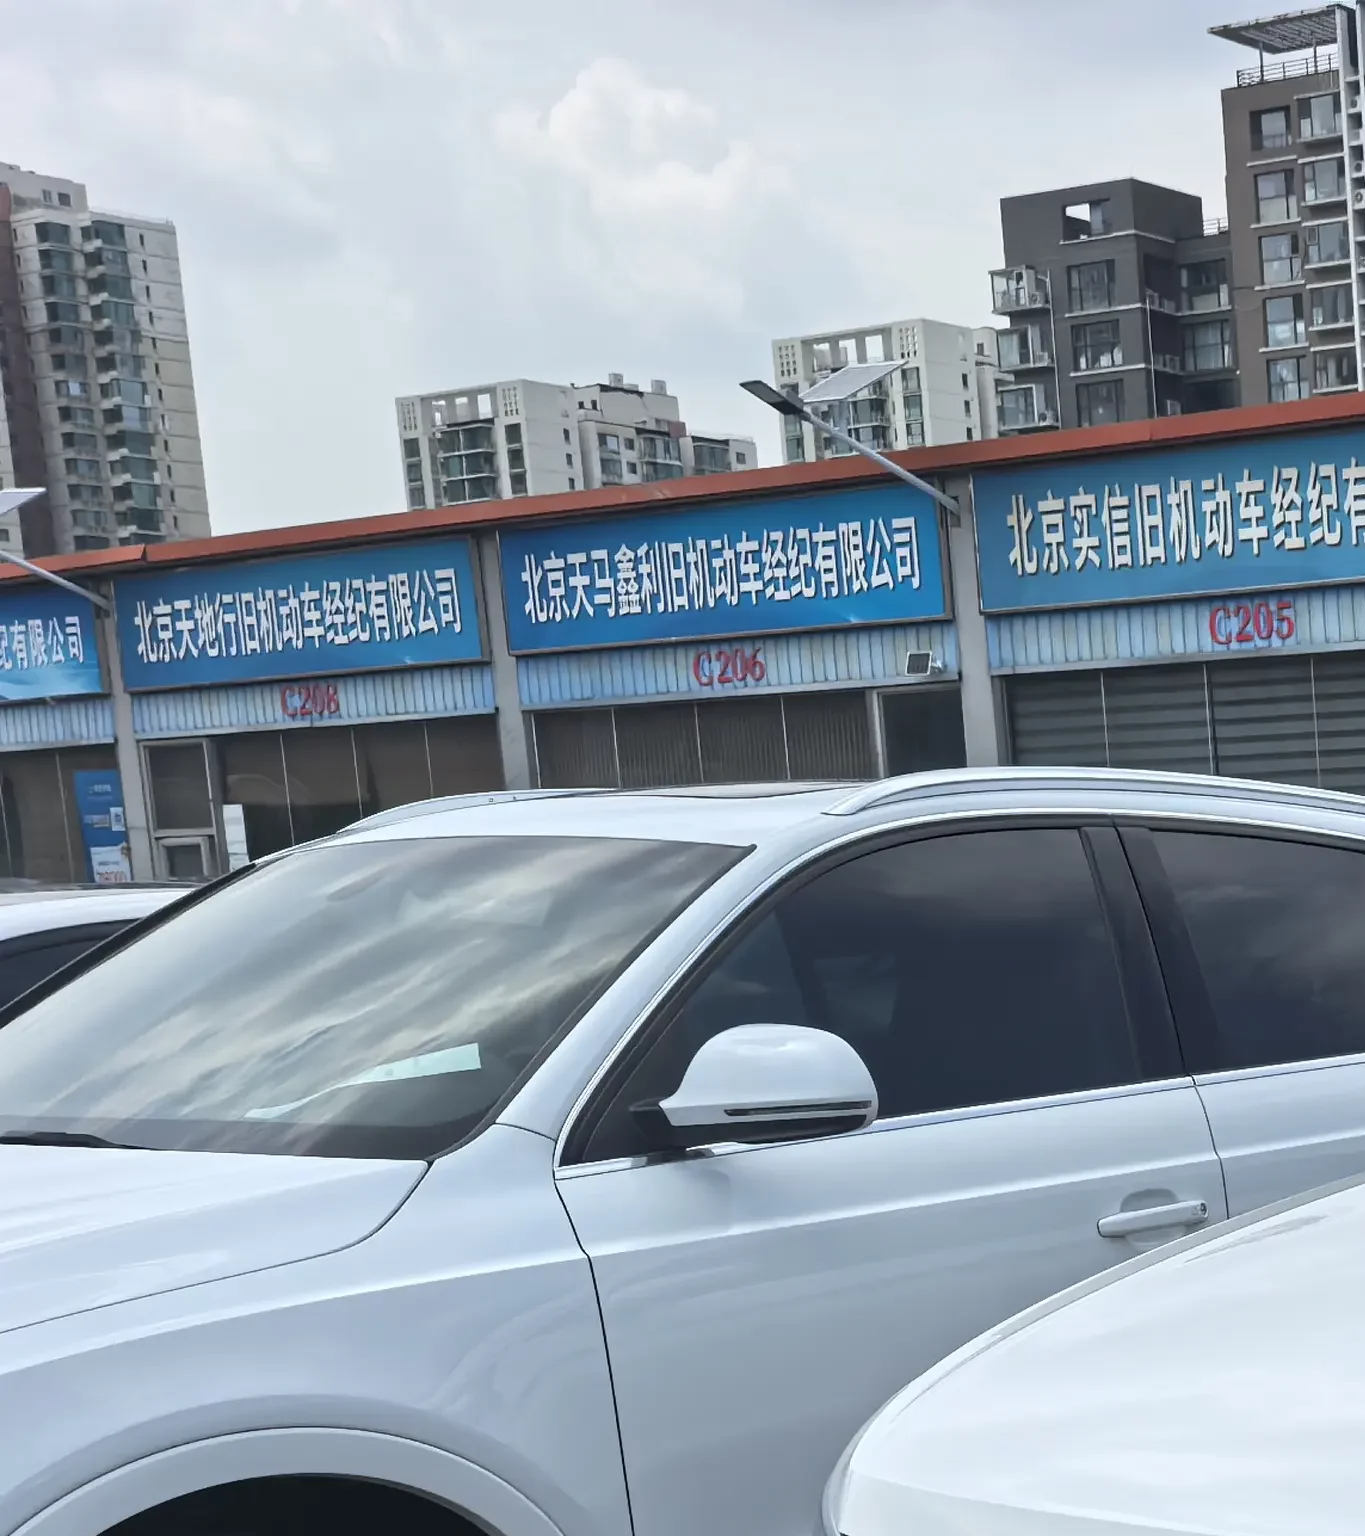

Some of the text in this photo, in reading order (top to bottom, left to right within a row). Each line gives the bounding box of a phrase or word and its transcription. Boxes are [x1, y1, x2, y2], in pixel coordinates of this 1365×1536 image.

[521, 516, 921, 624] 北京天马鑫利旧机动车经纪有限公司
[134, 568, 463, 665] 北京天地行旧机动车经纪有限公司
[1209, 601, 1296, 646] C205
[693, 646, 765, 687] C206
